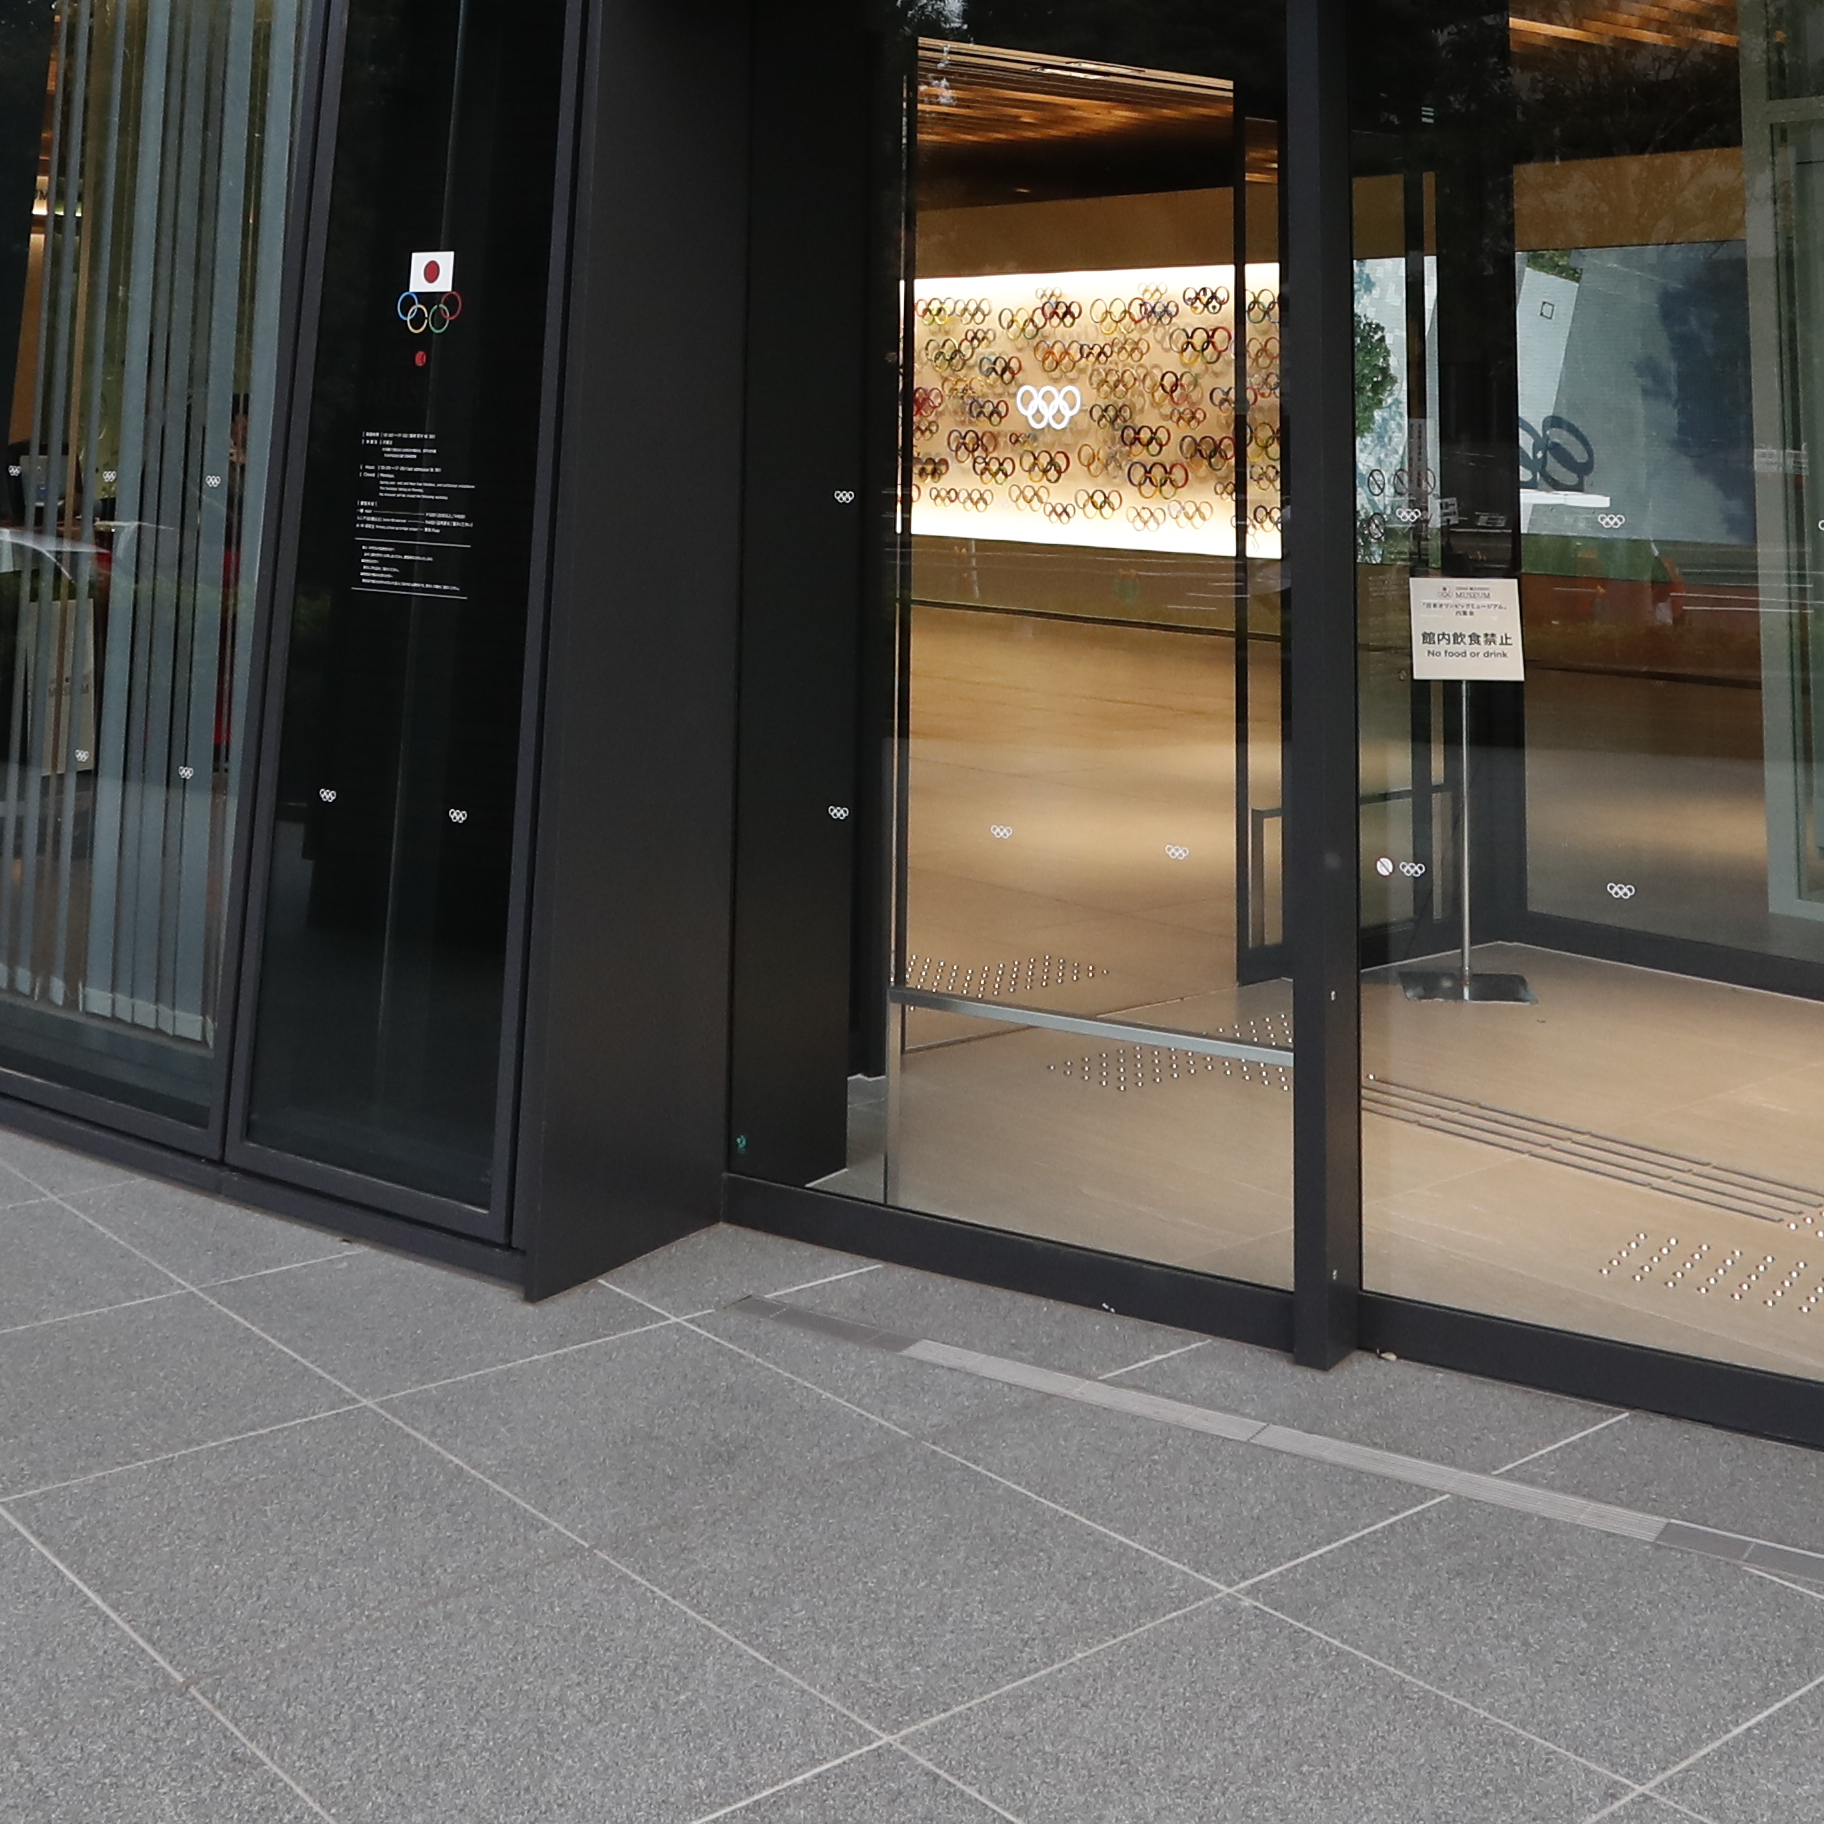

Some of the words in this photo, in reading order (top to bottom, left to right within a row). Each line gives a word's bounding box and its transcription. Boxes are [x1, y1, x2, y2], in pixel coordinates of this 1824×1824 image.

[1421, 631, 1513, 646] 館内飲食禁止
[1427, 649, 1442, 658] No
[1444, 649, 1467, 658] food
[1483, 650, 1509, 659] drink
